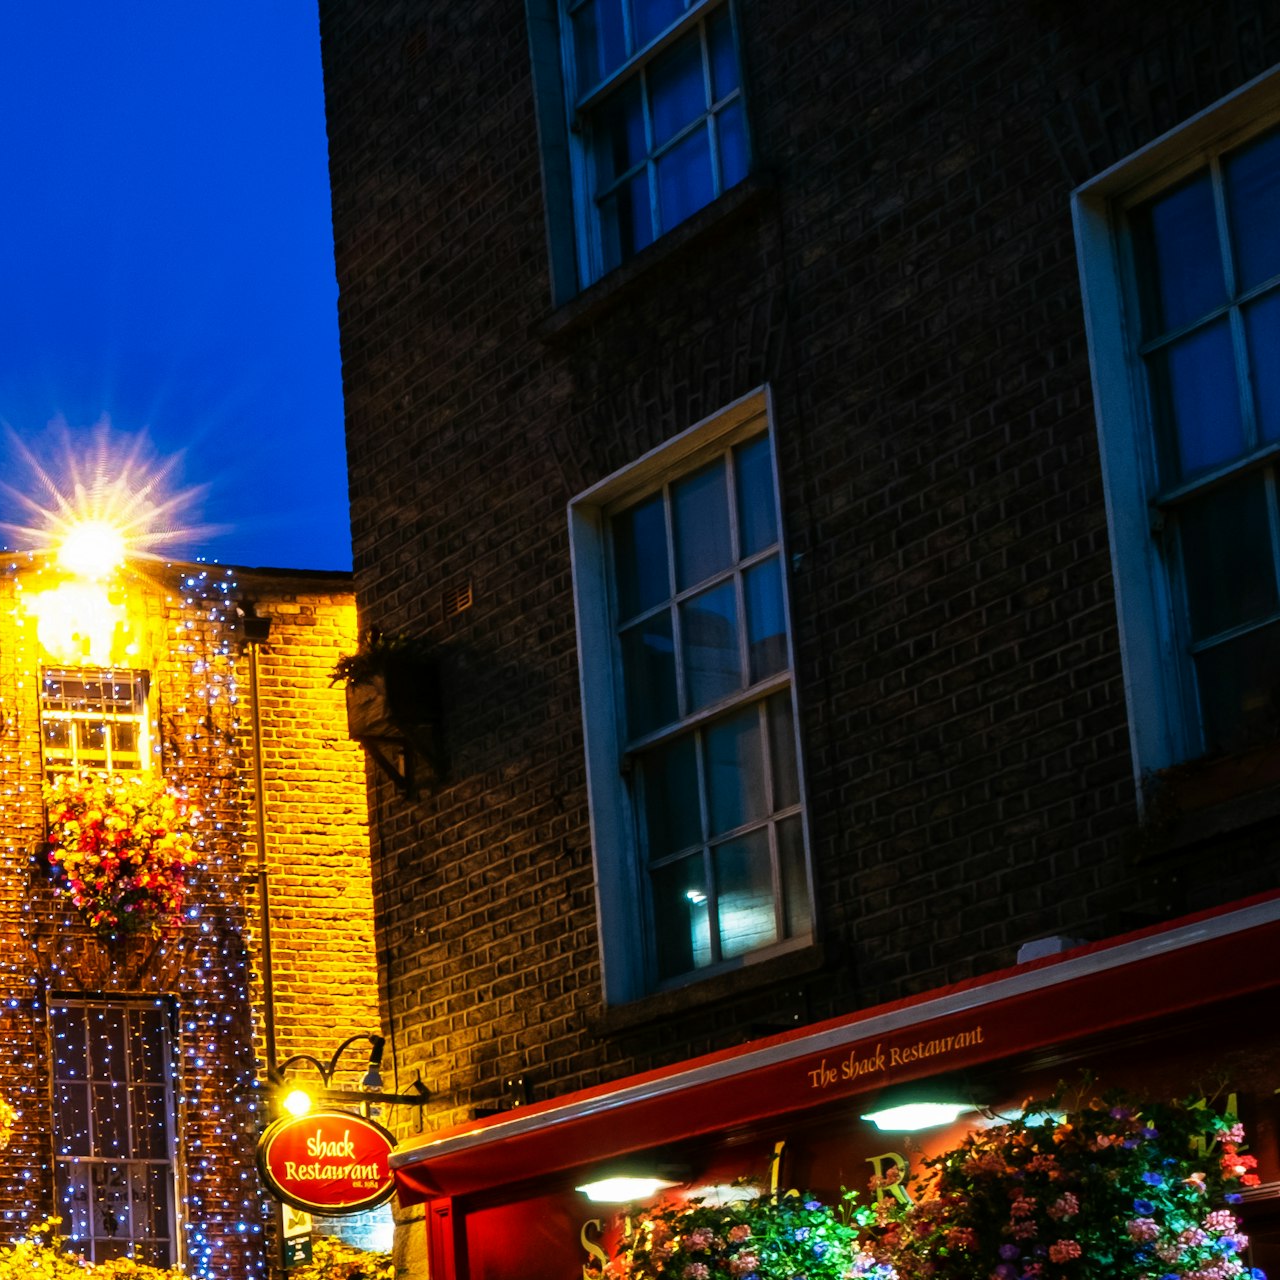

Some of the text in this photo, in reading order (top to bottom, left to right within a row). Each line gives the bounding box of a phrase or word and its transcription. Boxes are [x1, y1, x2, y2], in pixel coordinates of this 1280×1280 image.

[808, 1025, 985, 1089] The Shack Restaurant
[307, 1129, 356, 1160] Shack
[284, 1162, 381, 1182] Restaurant
